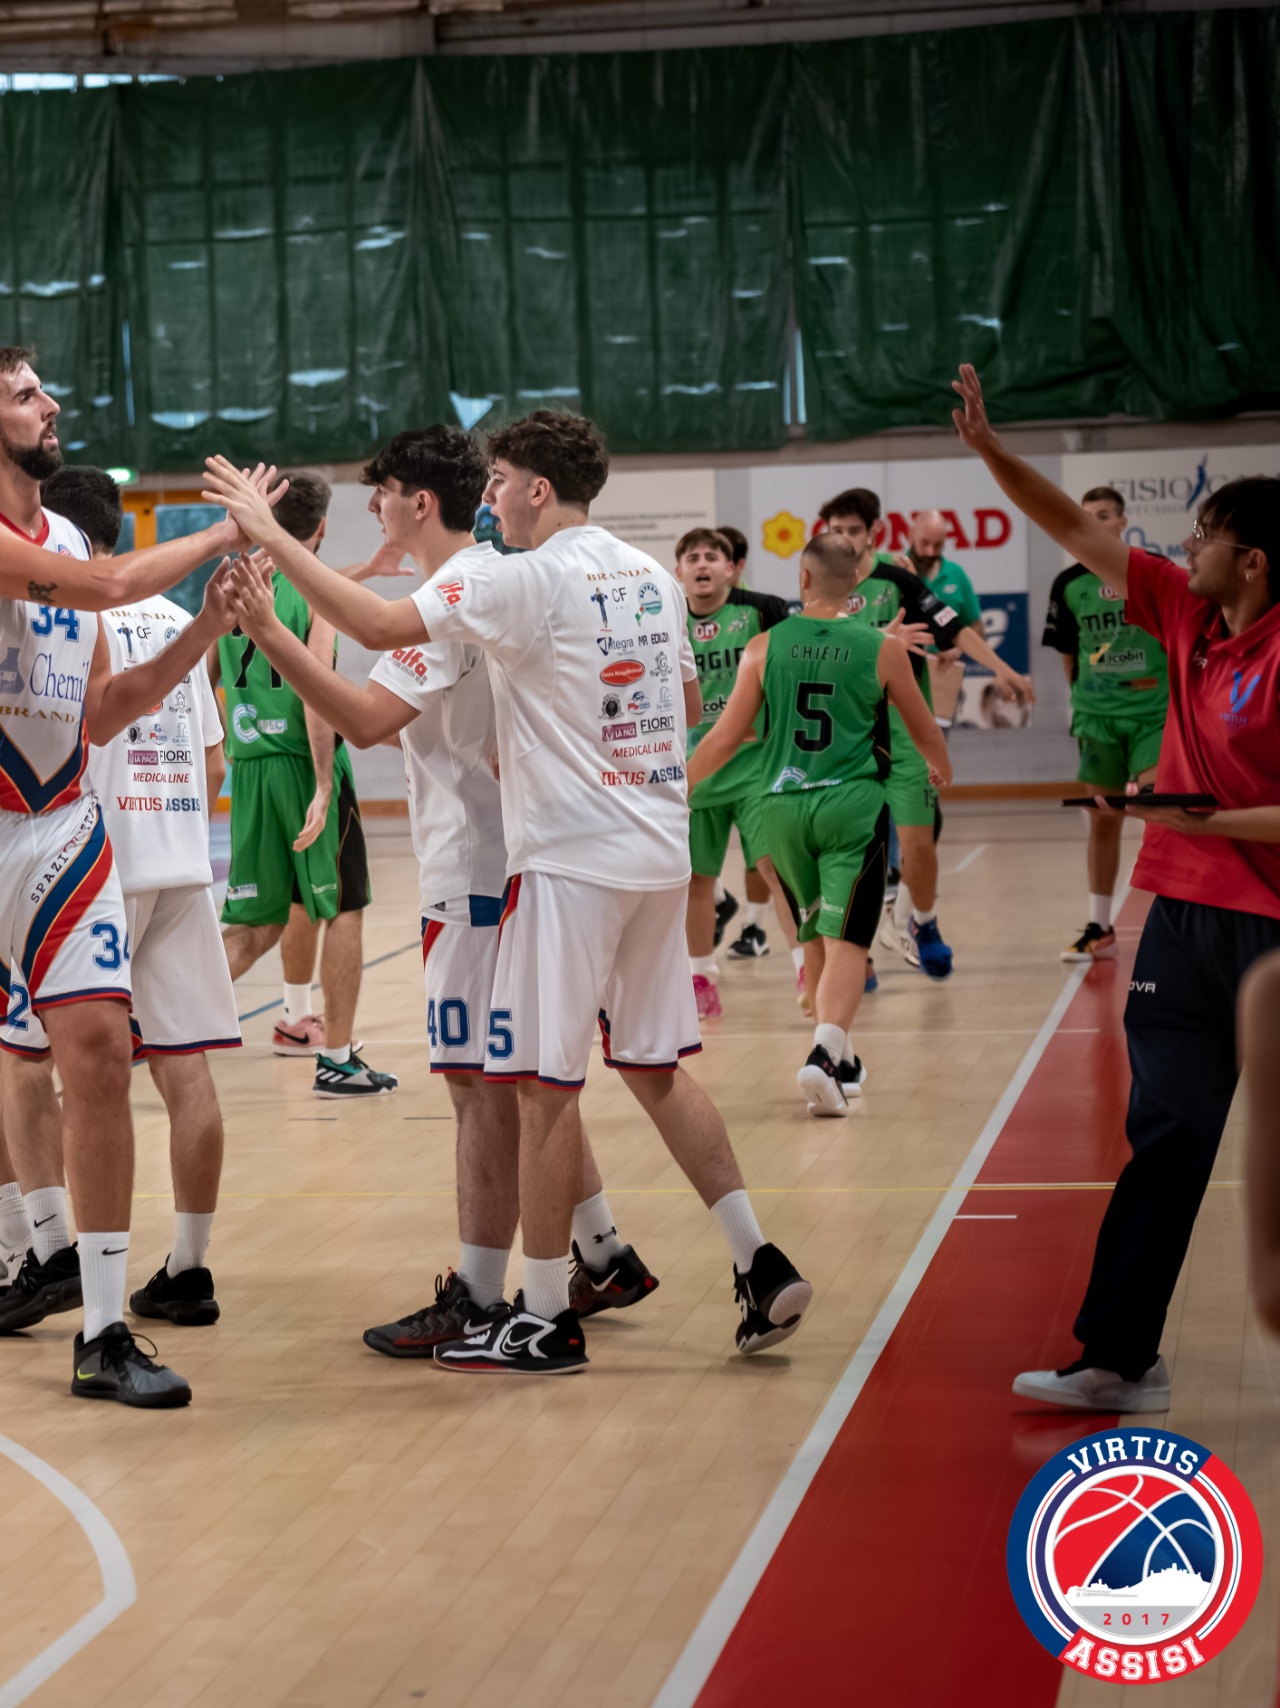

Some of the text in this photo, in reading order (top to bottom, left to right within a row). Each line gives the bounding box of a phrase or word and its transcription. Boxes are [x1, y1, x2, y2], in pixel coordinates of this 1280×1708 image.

[812, 508, 1012, 552] NAD
[587, 567, 652, 582] BRANDA
[612, 586, 627, 602] CF
[31, 604, 81, 643] 34
[790, 644, 850, 663] CHIETI
[793, 681, 835, 752] 5
[612, 740, 673, 758] MEDICAL LINE
[168, 773, 190, 783] LINE
[117, 796, 200, 812] VIRTUS ASSIS
[90, 920, 130, 971] 3
[7, 982, 31, 1031] 2
[427, 996, 471, 1049] 40
[487, 1007, 515, 1060] 5
